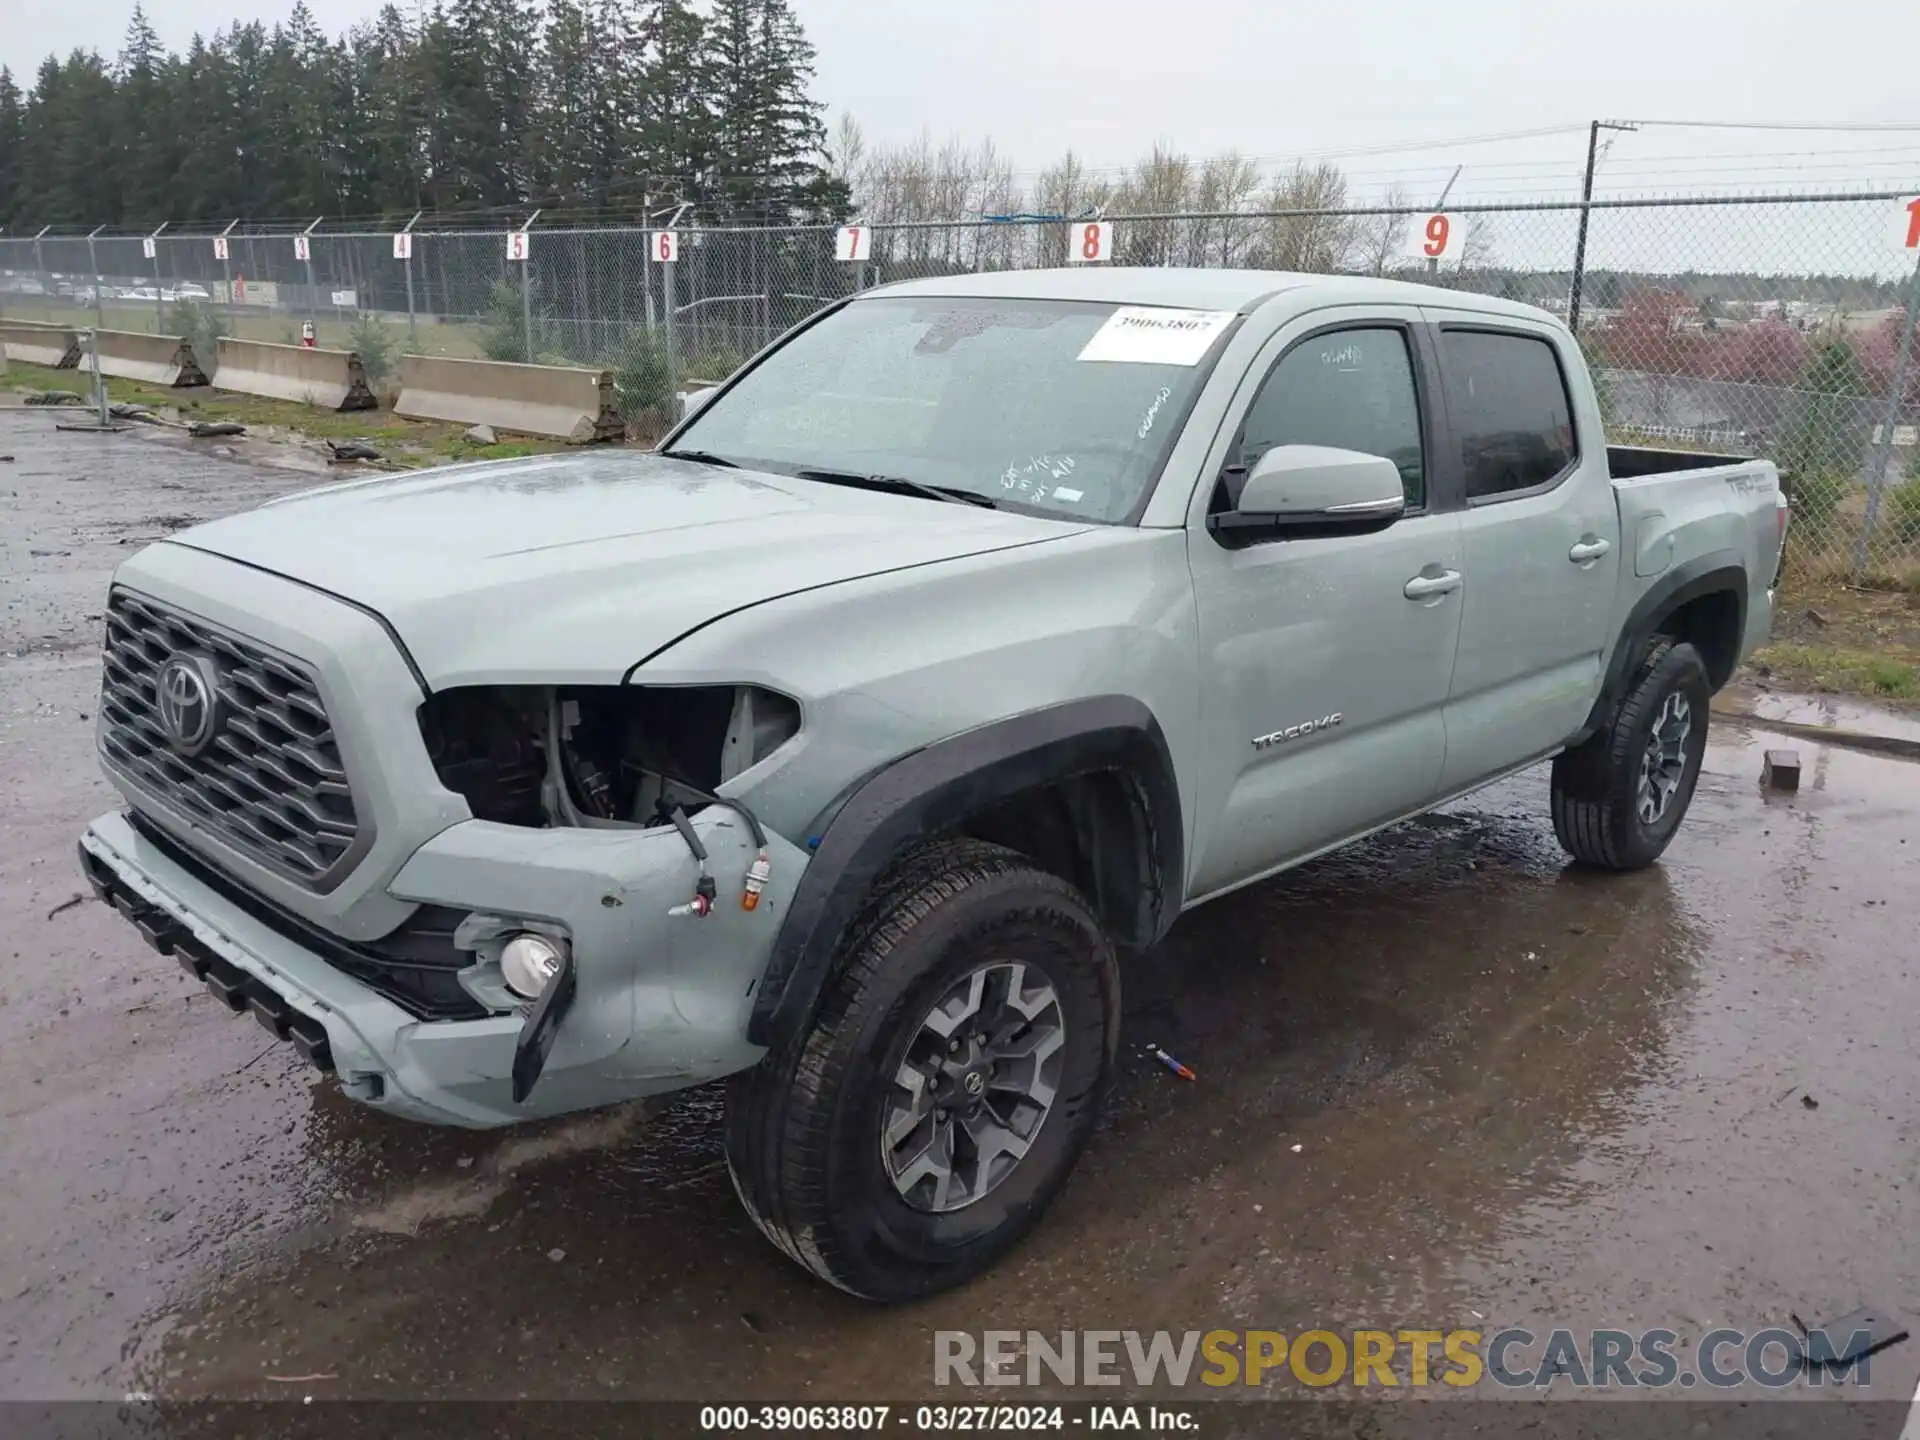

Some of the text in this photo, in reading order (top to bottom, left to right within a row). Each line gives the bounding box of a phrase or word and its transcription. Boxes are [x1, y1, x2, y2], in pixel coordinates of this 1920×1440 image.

[217, 239, 226, 258] 2
[299, 238, 308, 259] 3
[398, 232, 407, 257] 4
[513, 233, 524, 258] 5
[659, 233, 671, 261] 6
[847, 228, 861, 259] 7
[1082, 223, 1100, 259] 8
[1423, 214, 1450, 257] 9
[1251, 711, 1343, 748] TACOMA
